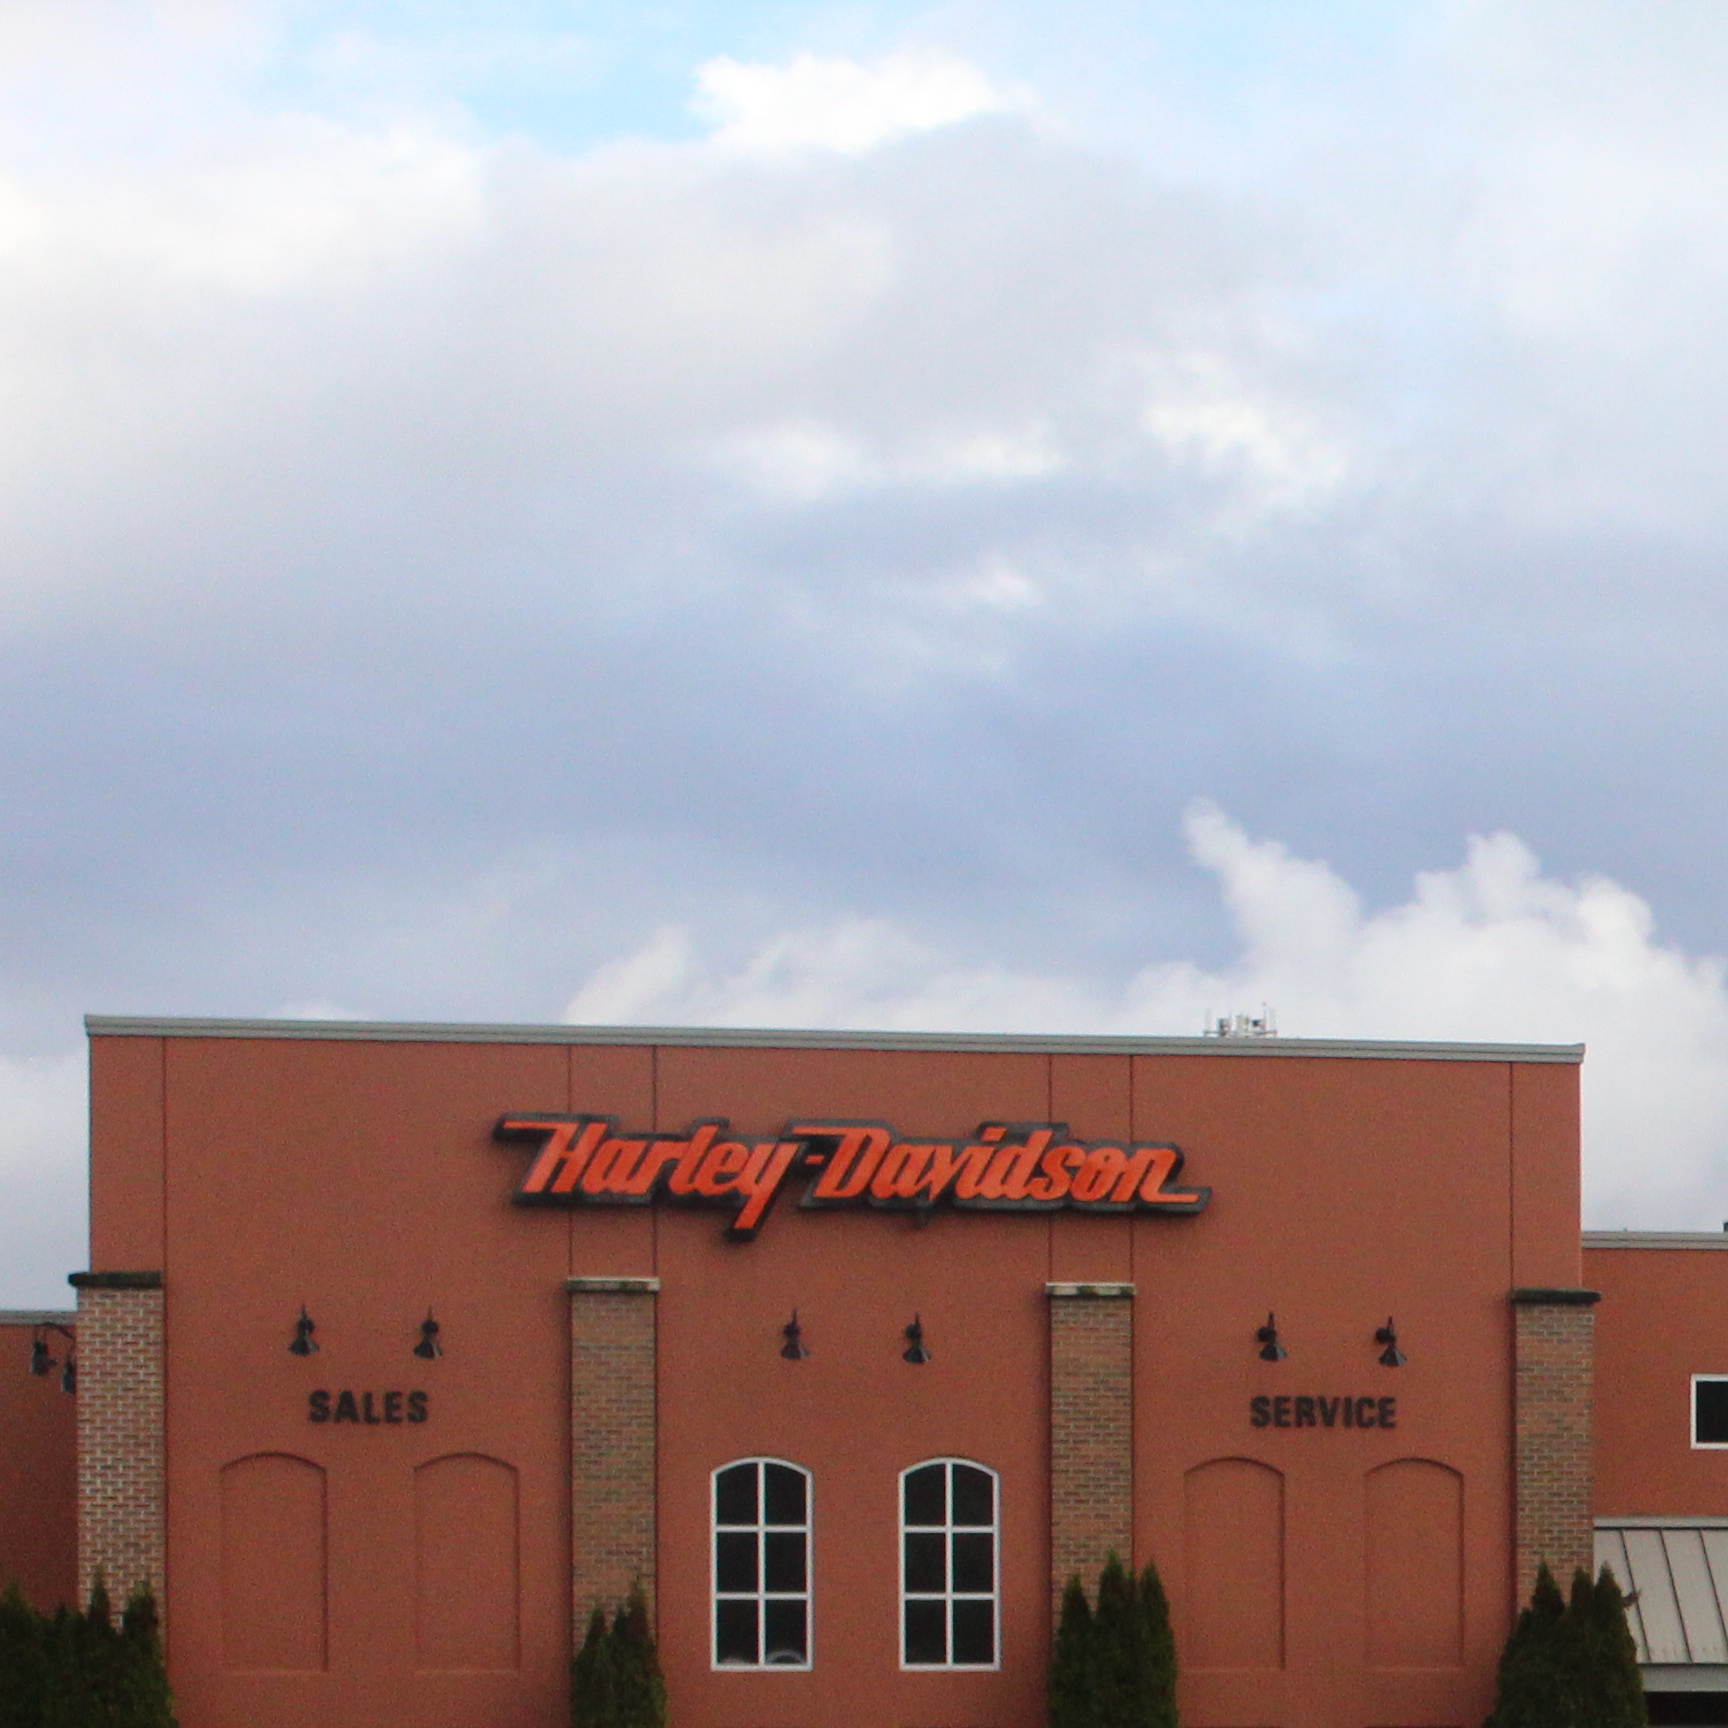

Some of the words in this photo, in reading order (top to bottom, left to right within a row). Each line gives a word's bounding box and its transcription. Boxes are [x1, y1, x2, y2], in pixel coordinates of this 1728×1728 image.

[503, 1120, 1199, 1229] Harley-Davidson
[309, 1391, 428, 1424] SALES
[1251, 1396, 1396, 1428] SERVICE
